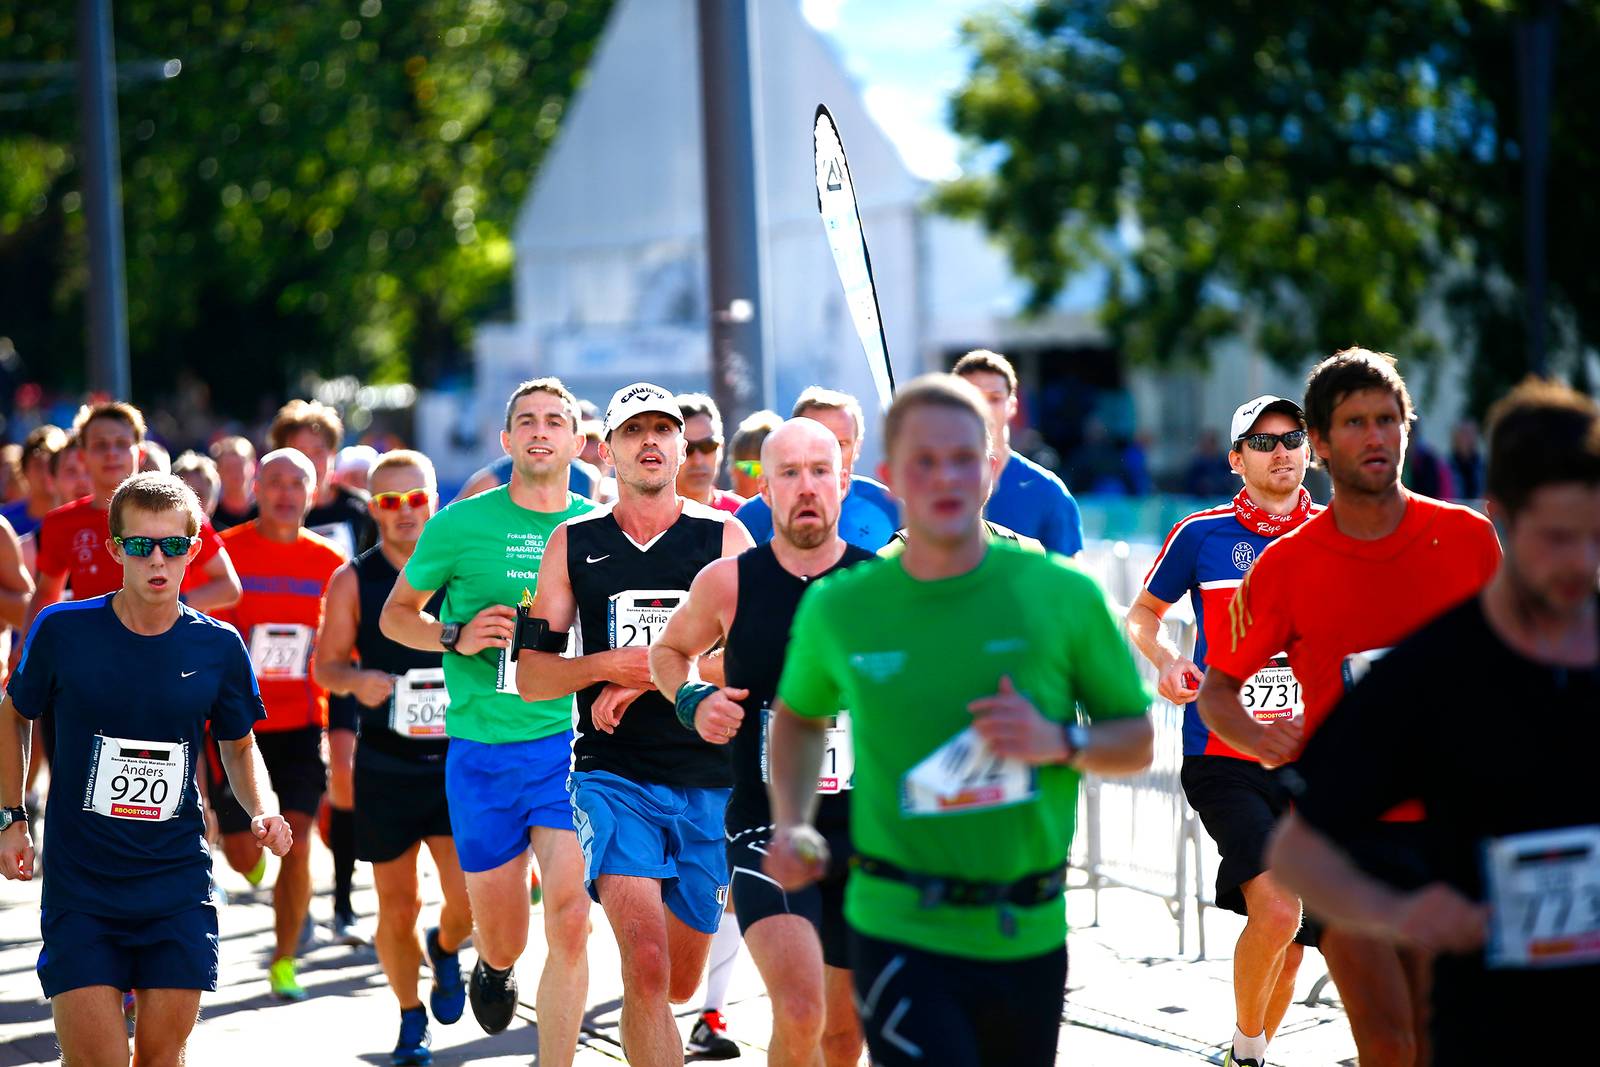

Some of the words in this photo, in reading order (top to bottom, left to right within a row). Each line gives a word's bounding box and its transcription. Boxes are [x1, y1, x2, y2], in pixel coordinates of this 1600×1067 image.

[621, 387, 665, 404] Callaway
[1256, 521, 1281, 535] Rye
[506, 532, 527, 540] Fokus
[524, 539, 544, 547] OSLO
[1234, 550, 1252, 563] RYE
[496, 661, 504, 689] Maraton
[1254, 674, 1293, 684] Morten
[1244, 682, 1299, 708] 3731
[407, 703, 446, 724] 504
[121, 764, 164, 777] Anders
[84, 778, 94, 807] Maraton
[111, 775, 168, 804] 920
[114, 807, 159, 816] #BOOSTOSLO
